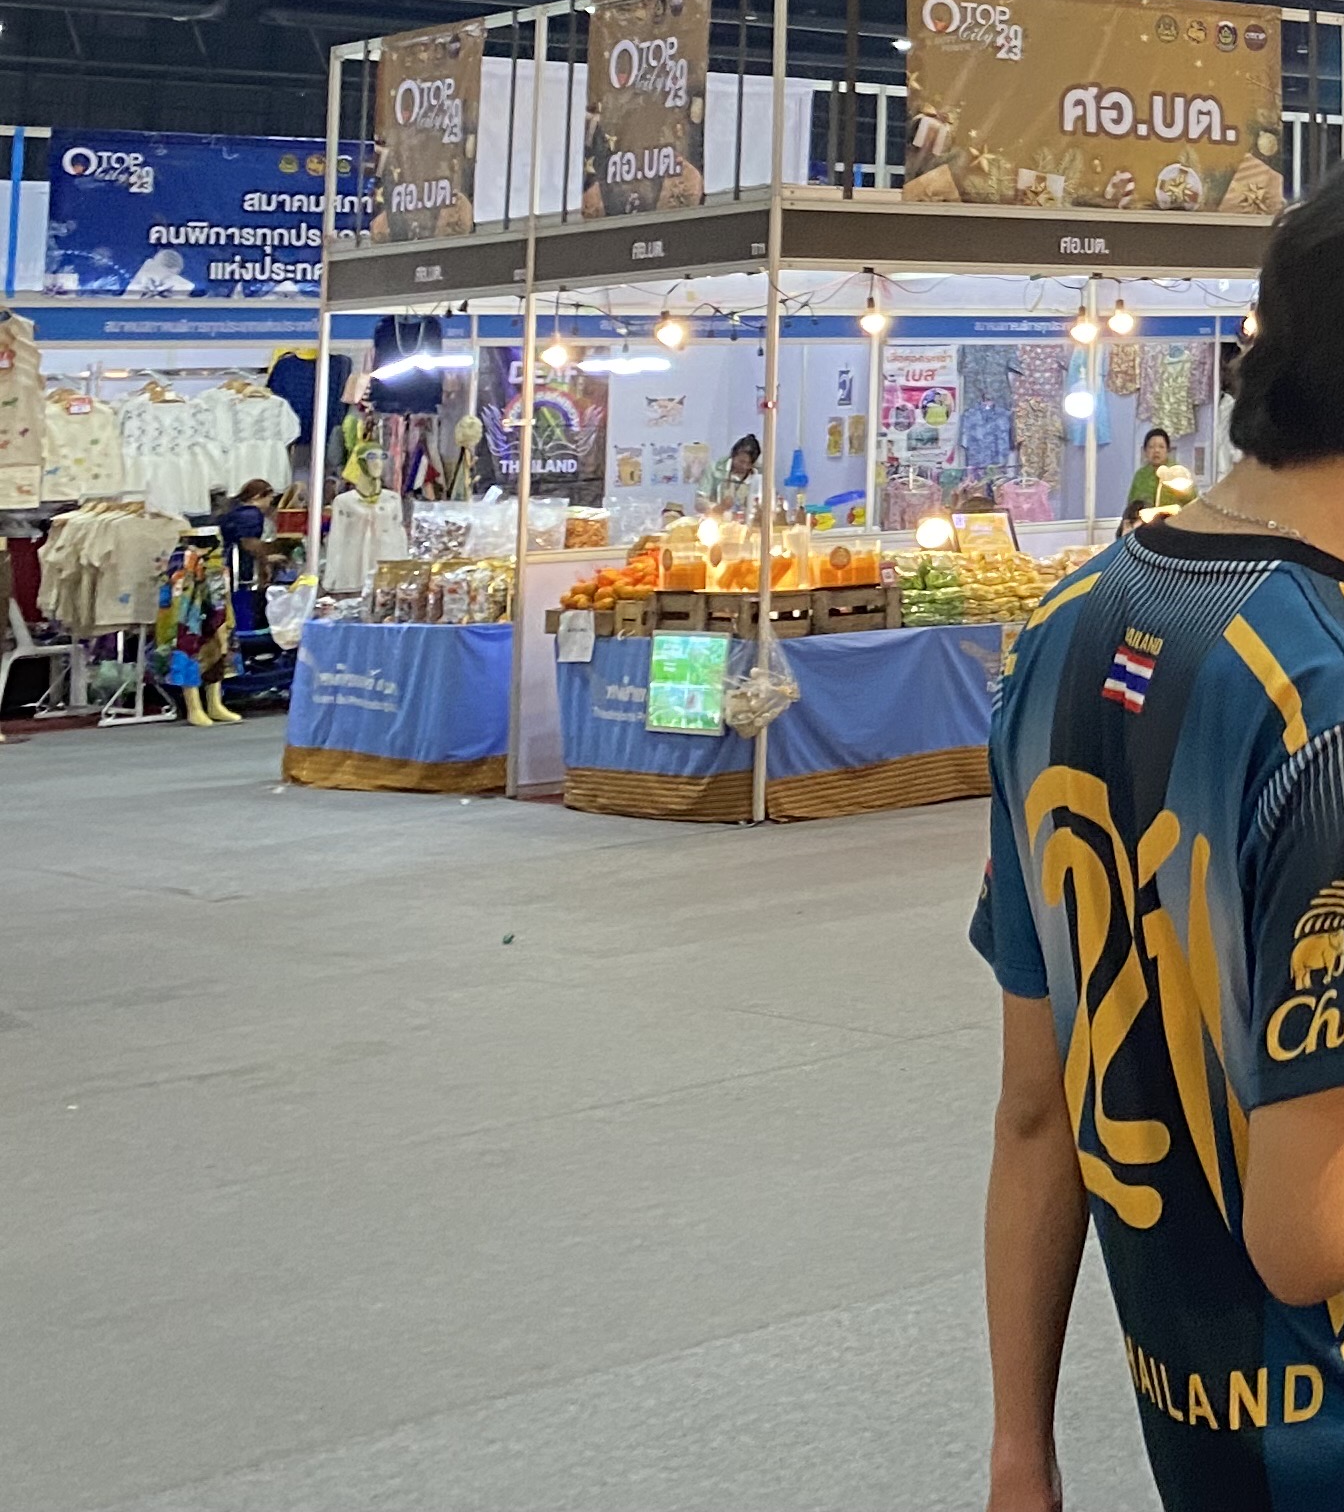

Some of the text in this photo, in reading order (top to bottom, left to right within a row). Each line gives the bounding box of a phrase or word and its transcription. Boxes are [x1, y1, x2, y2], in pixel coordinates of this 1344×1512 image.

[609, 37, 678, 89] OTOP
[395, 78, 455, 125] OTOP
[1062, 86, 1237, 142] ศอ.บต.
[62, 147, 143, 177] OTOP
[606, 146, 682, 184] ศอ.บต.
[391, 179, 457, 213] ศอ.บต.
[1060, 236, 1110, 255] ศอ.บต.
[500, 459, 578, 474] THILAND
